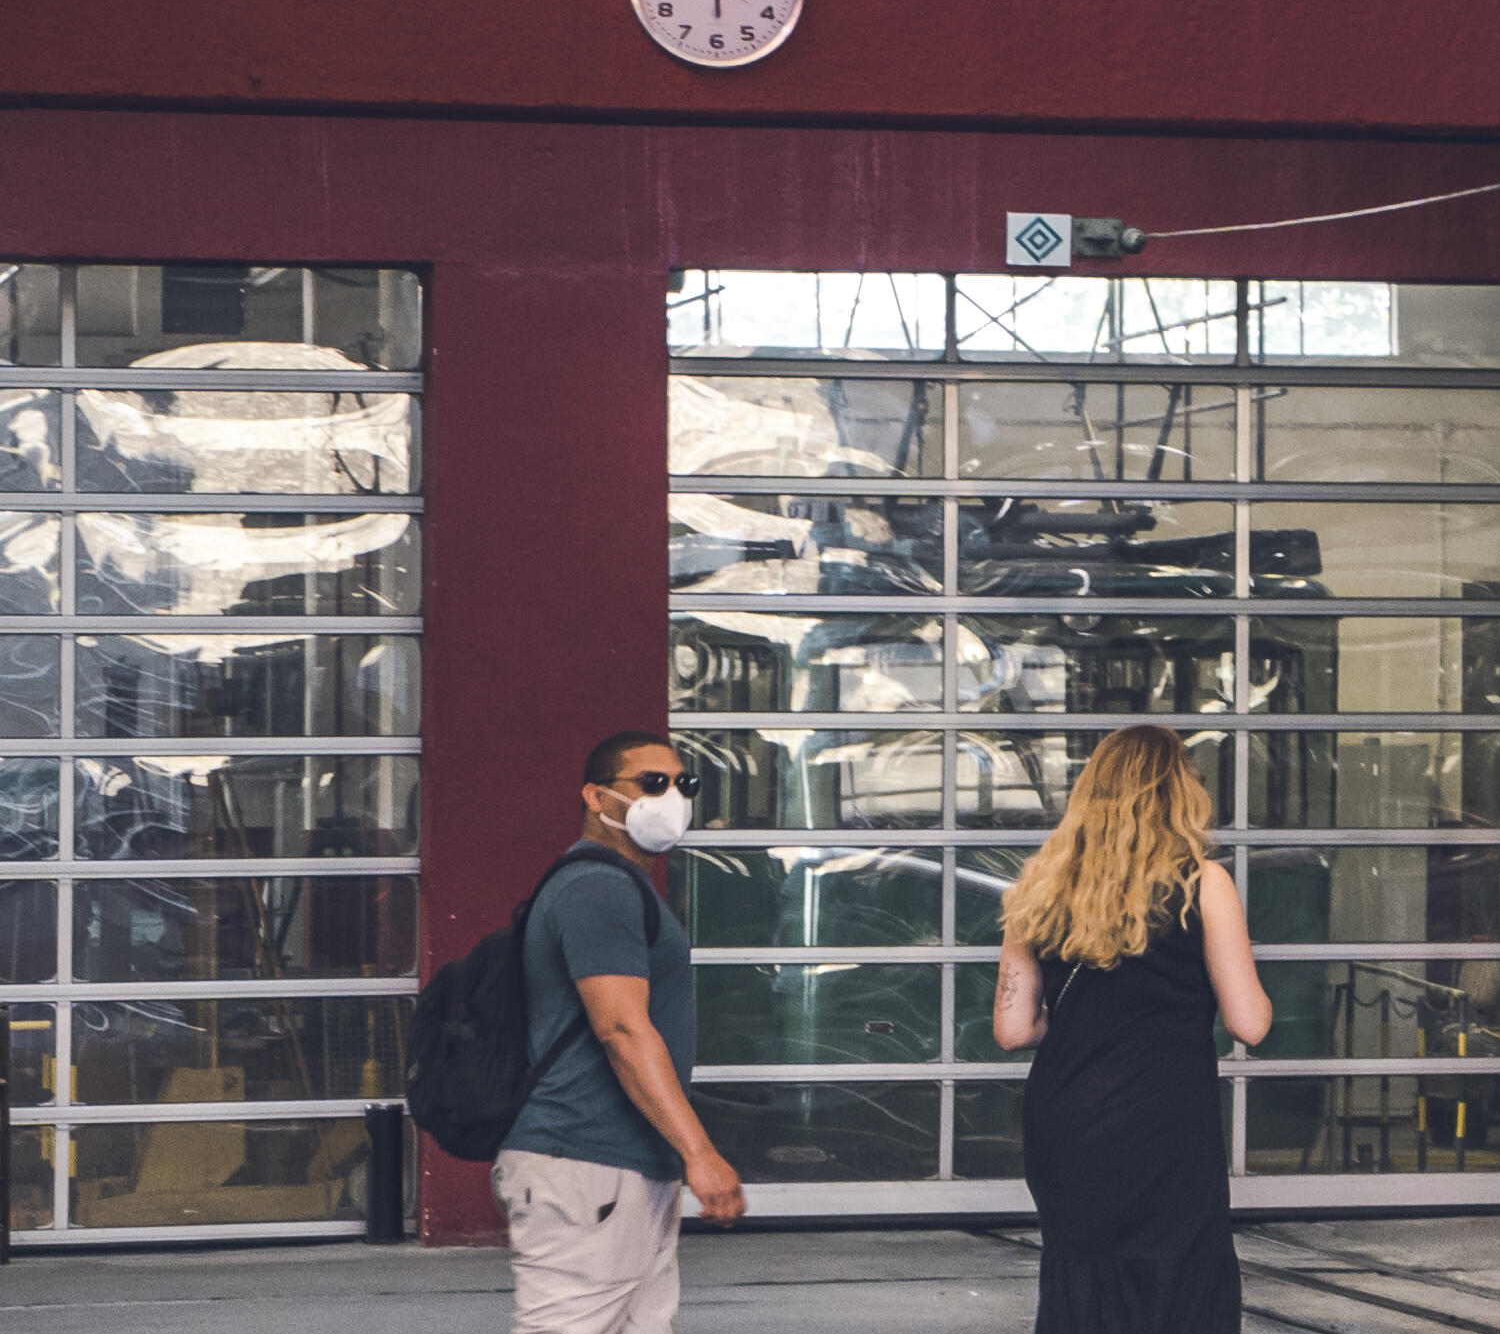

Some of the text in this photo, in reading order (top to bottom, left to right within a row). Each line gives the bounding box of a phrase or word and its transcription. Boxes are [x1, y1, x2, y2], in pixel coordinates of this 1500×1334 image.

[657, 2, 673, 18] 8
[760, 5, 775, 20] 4
[678, 24, 692, 40] 7
[740, 25, 755, 41] 5
[708, 33, 724, 49] 6
